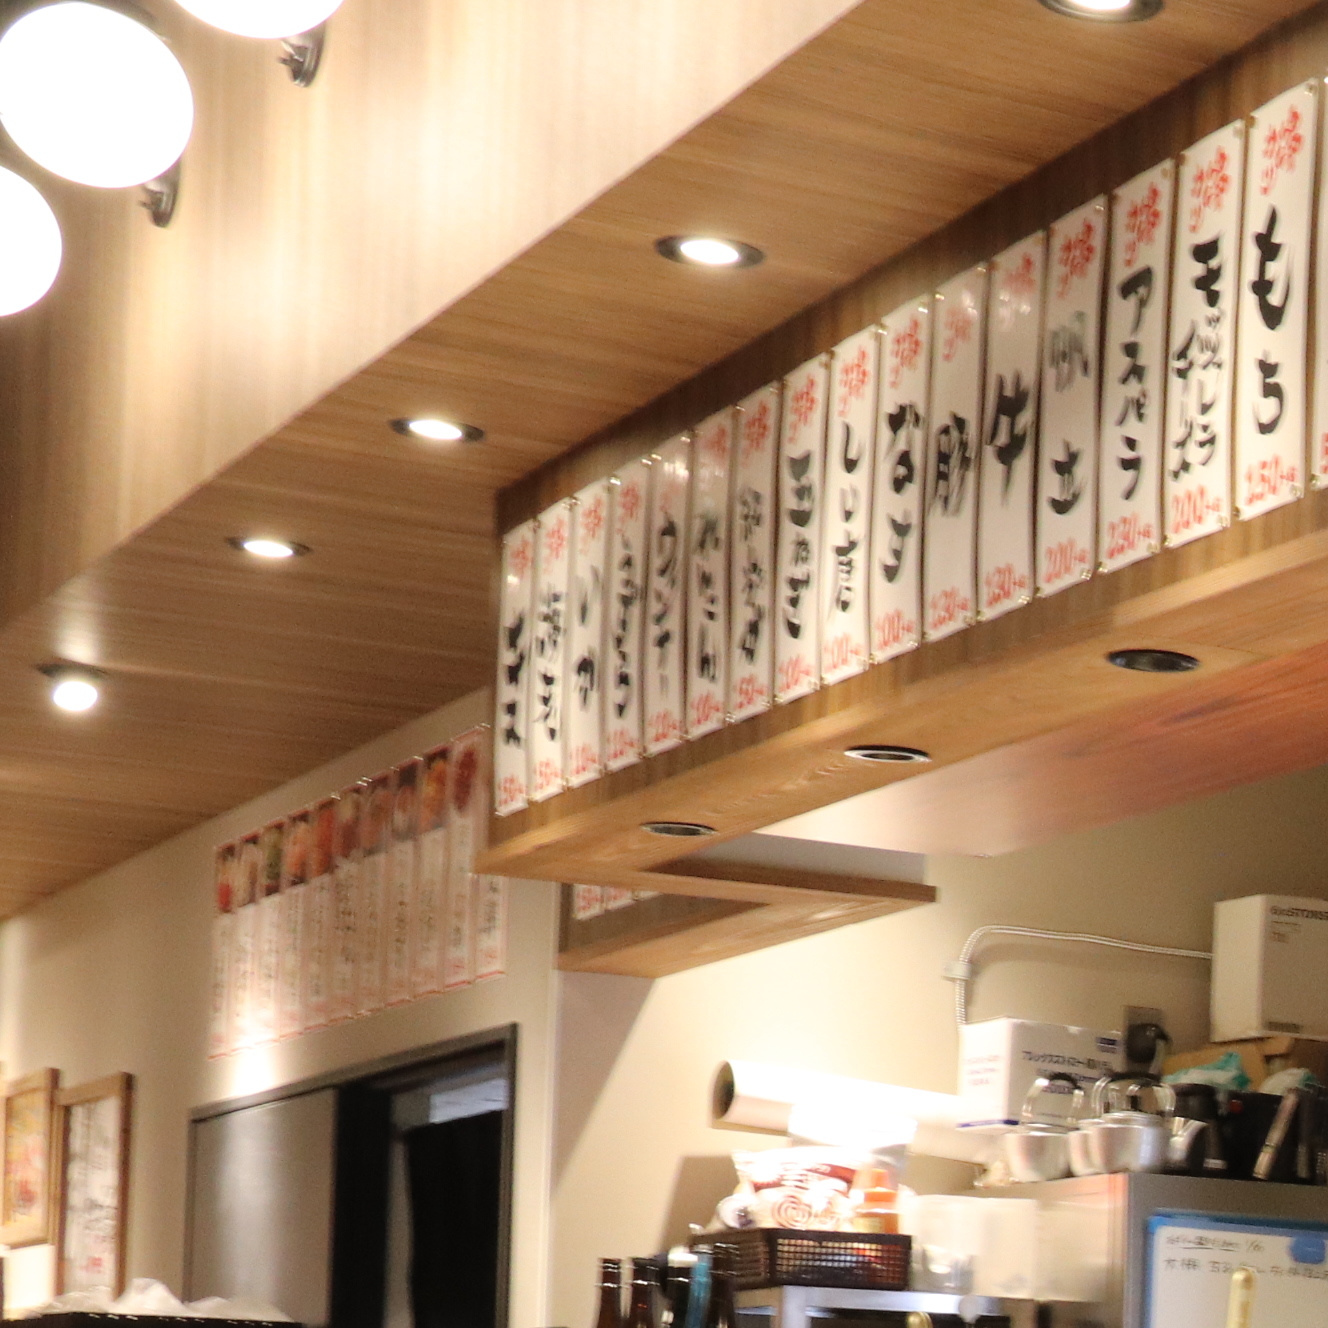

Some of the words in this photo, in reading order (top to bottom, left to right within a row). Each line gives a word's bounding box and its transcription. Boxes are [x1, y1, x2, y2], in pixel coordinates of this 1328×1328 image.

[1118, 268, 1154, 500] アスパラ
[1250, 206, 1289, 435] もち
[883, 402, 921, 582] なす
[989, 370, 1031, 500] 牛
